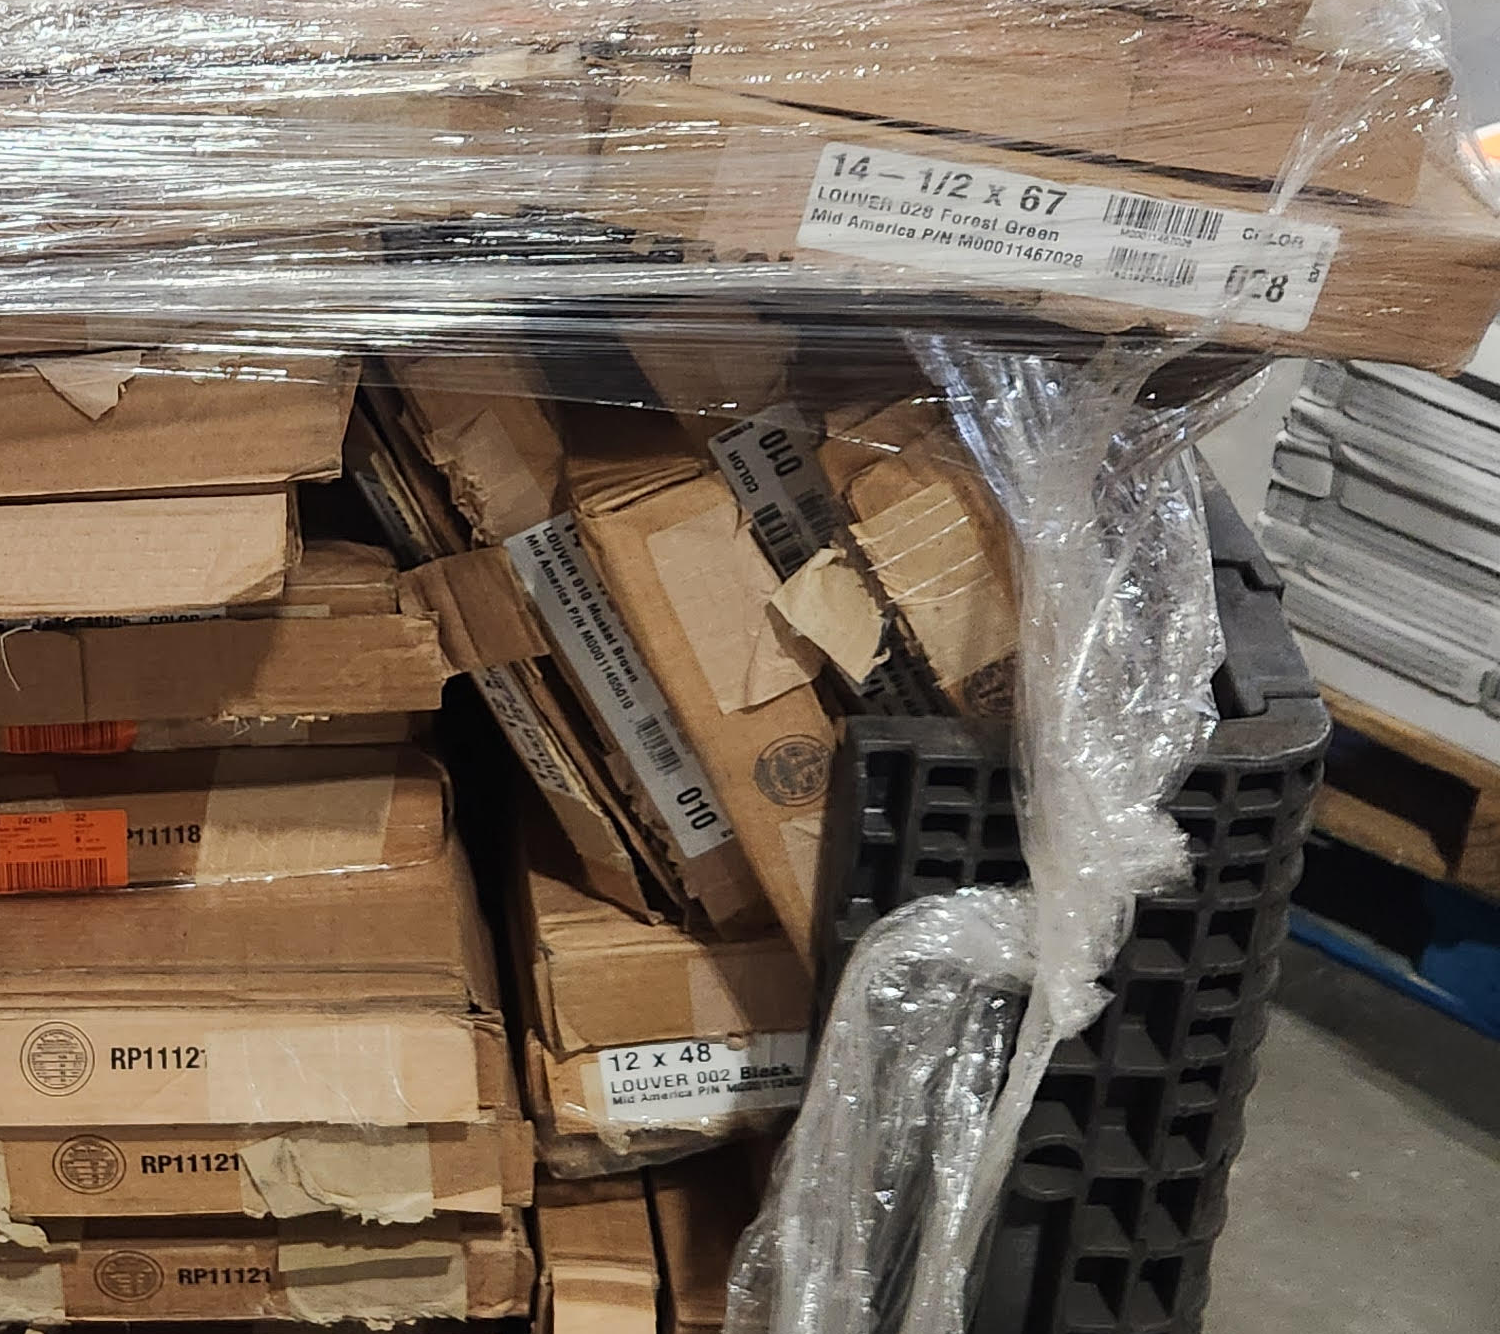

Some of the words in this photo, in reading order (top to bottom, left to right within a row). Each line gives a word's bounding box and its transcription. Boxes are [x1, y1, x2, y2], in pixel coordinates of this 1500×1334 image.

[832, 153, 871, 180] 14
[919, 167, 973, 199] 1/2
[982, 183, 1006, 206] x
[1019, 185, 1068, 216] 67
[810, 208, 842, 226] Mid
[847, 215, 916, 239] America
[921, 229, 952, 246] P/N
[817, 185, 892, 213] LOUVER
[900, 201, 935, 219] 028
[940, 208, 999, 232] Forest
[1005, 220, 1060, 243] Green
[1242, 227, 1304, 249] CLOR
[728, 450, 759, 493] COLOR
[759, 429, 802, 477] 010
[525, 533, 545, 558] Mid
[539, 559, 571, 606] America
[567, 605, 586, 629] P/N
[542, 526, 578, 577] LOUVER
[573, 577, 593, 601] 010
[587, 601, 619, 646] Musket
[612, 644, 639, 683] Brown
[676, 786, 718, 830] 010
[127, 824, 202, 846] 11118
[609, 1051, 640, 1072] 12
[653, 1052, 668, 1068] x
[680, 1043, 712, 1064] 48
[611, 1072, 689, 1094] LOUVER
[697, 1069, 730, 1085] 002
[612, 1096, 635, 1105] Mid
[641, 1089, 693, 1103] America
[698, 1085, 720, 1095] P/N
[141, 1153, 240, 1174] RP11121
[178, 1267, 271, 1285] RP11121
